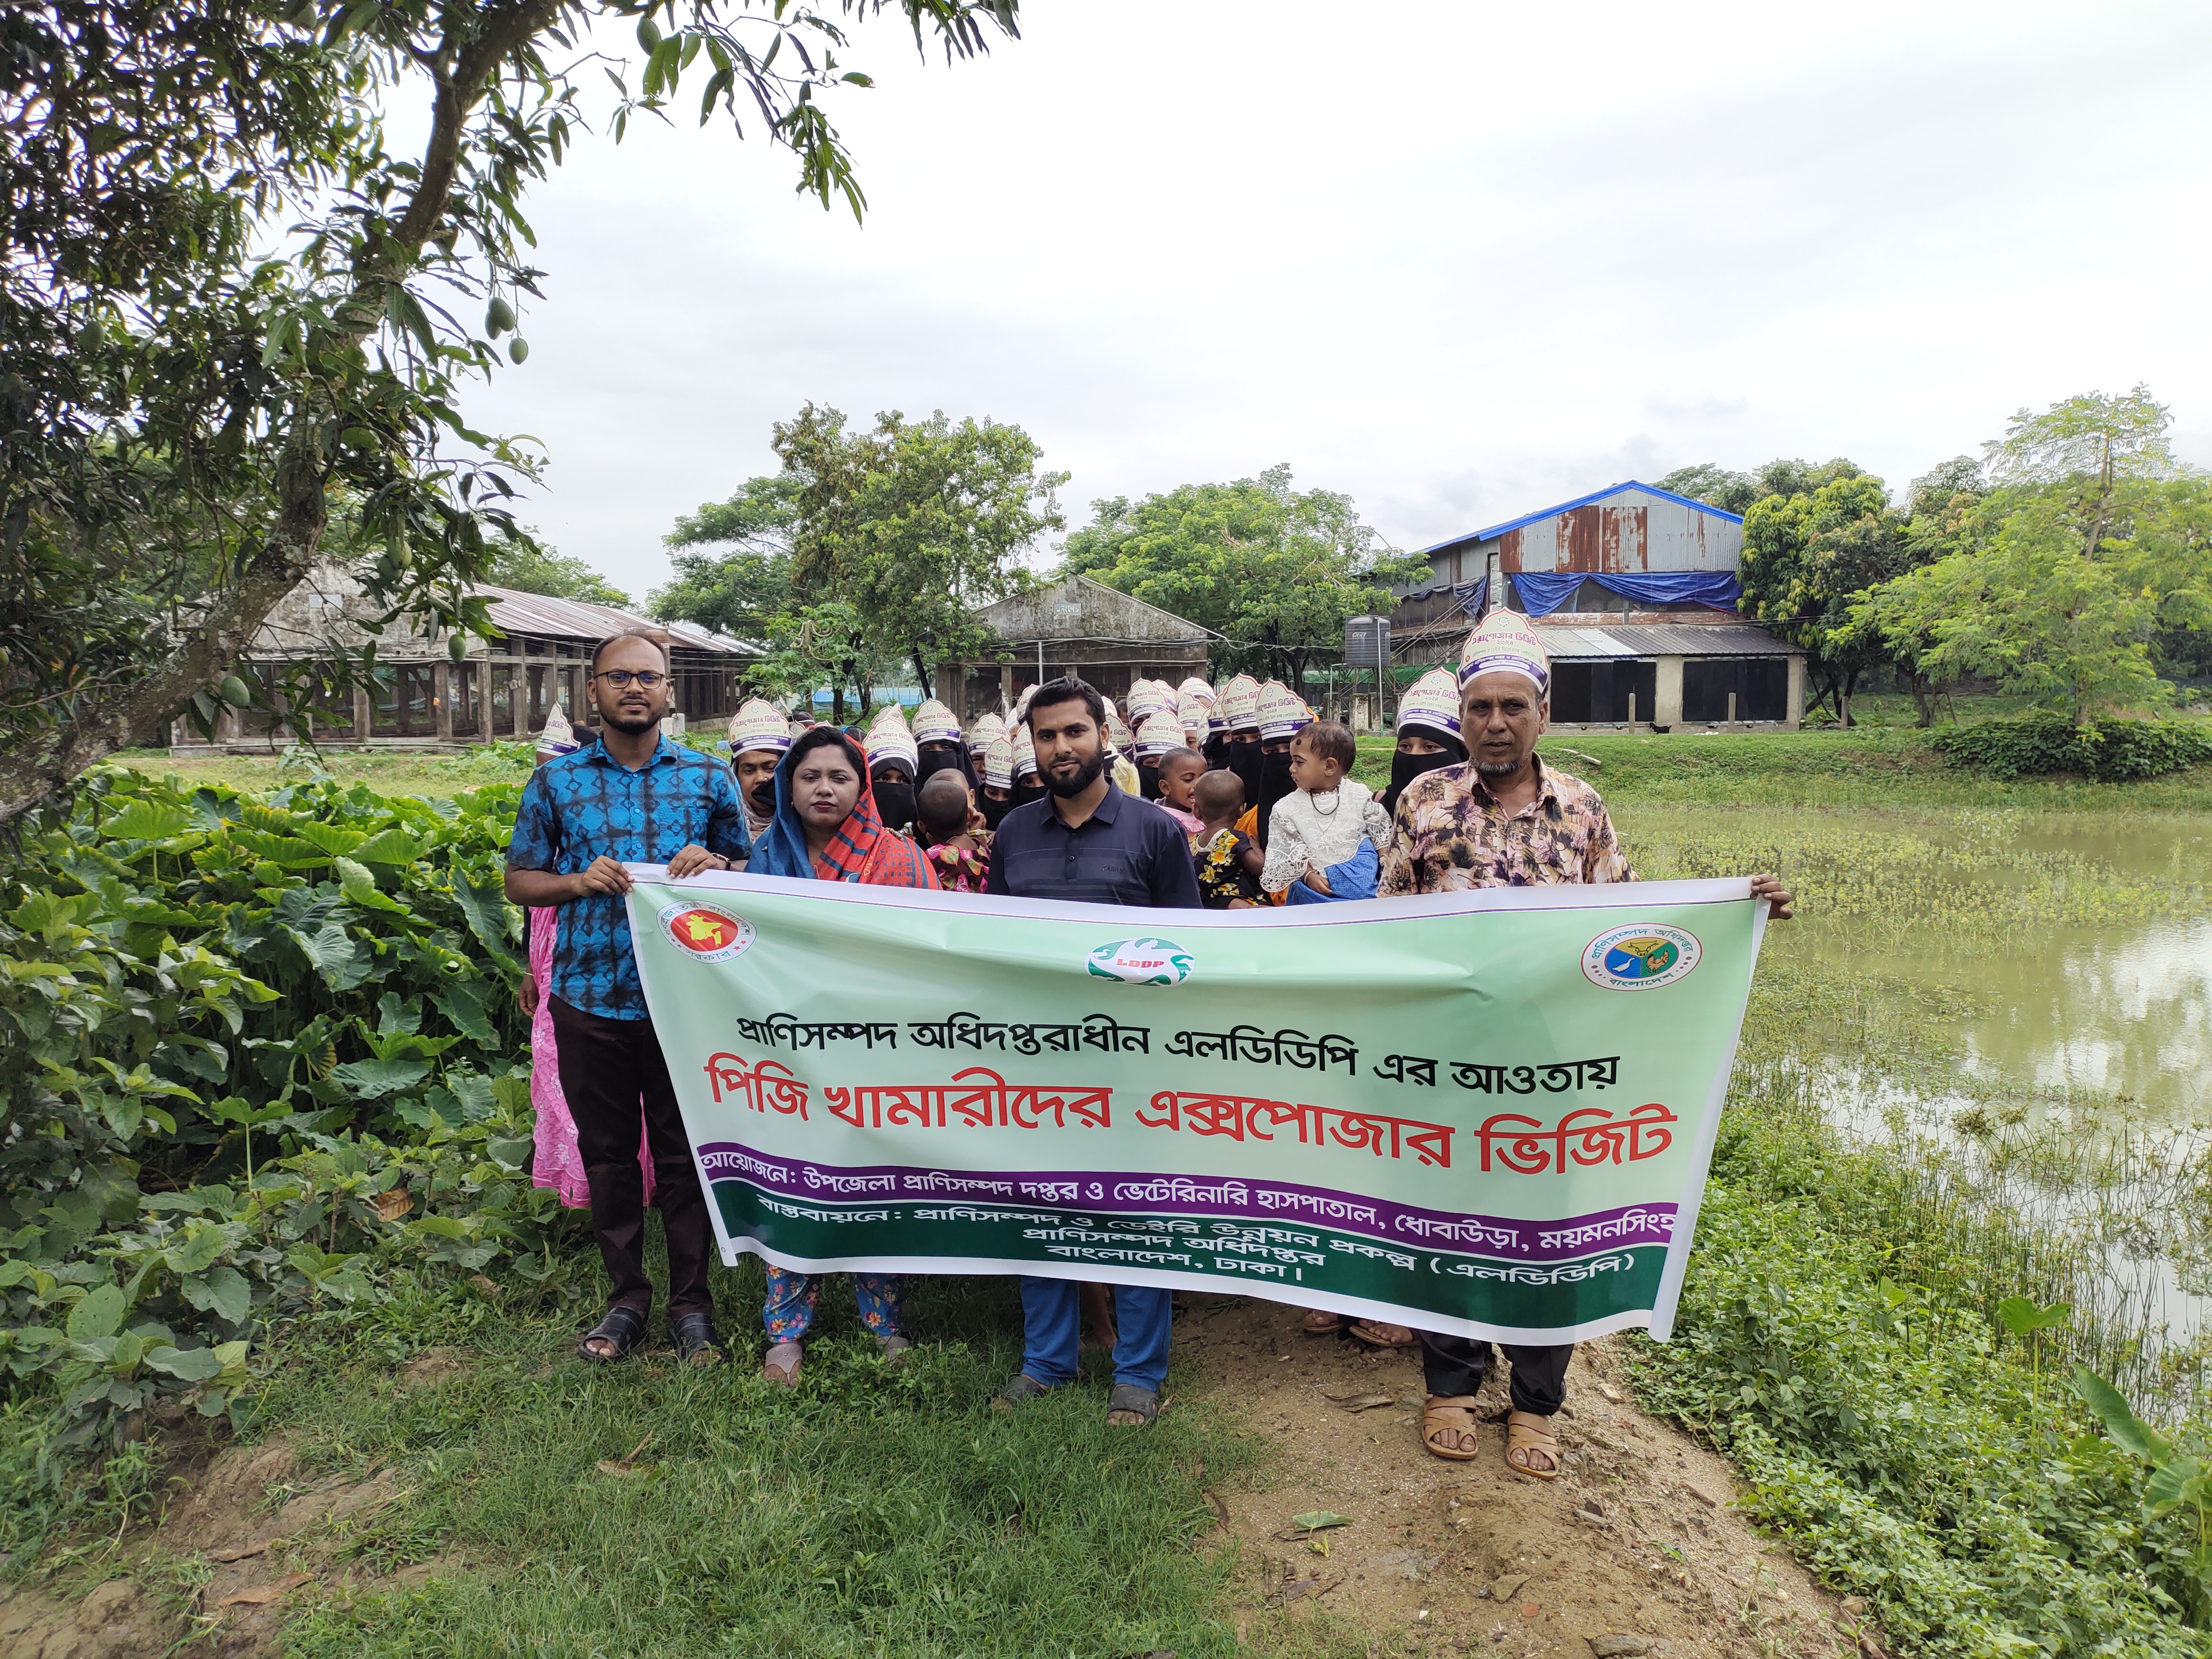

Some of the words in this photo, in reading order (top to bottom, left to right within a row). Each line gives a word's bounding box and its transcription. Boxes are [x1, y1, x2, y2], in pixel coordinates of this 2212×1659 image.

[1515, 632, 1537, 646] ভিজিট
[707, 904, 751, 936] বাংলাদেশ
[685, 949, 732, 961] সরকার
[1591, 928, 1650, 960] প্রাণিসম্পদ
[1654, 928, 1694, 952] অধিদপ্তর
[1116, 958, 1165, 969] LDDP
[1609, 973, 1675, 987] বাংলাদেশ
[736, 1012, 898, 1051] প্রাণিসম্পদ
[907, 1011, 1151, 1056] অধিদপ্তরাধীন
[1164, 1025, 1359, 1076] এলডিডিপি
[1373, 1054, 1439, 1087] এর
[1449, 1056, 1621, 1094] আওতায়
[704, 1051, 809, 1122] পিজি
[824, 1067, 1113, 1129] খামারীদের
[1135, 1091, 1455, 1169] এক্সপোজার
[1474, 1103, 1678, 1175] ভিজিট
[802, 1166, 896, 1193] উপজেলা
[903, 1172, 1013, 1197] প্রাণিসম্পদ
[1019, 1182, 1079, 1202] দপ্তর
[1085, 1182, 1104, 1201] ও
[1113, 1178, 1249, 1206] ভেটেরিনারি
[1255, 1190, 1386, 1230] হাসপাতাল,
[1395, 1214, 1529, 1252] ধোবাউড়া,
[1538, 1208, 1677, 1249] ময়মনসিংহ
[913, 1206, 1062, 1226] প্রাণিসম্পদ
[1070, 1217, 1094, 1227] ও
[1107, 1220, 1201, 1234] ডেইরি
[1209, 1223, 1320, 1247] উন্নয়ন
[1329, 1239, 1418, 1271] প্রকল্প
[1430, 1253, 1635, 1286] (এলডিডিপি)
[1022, 1227, 1175, 1248] প্রাণিসম্পদ
[1182, 1236, 1326, 1266] অধিদপ্তর
[1045, 1246, 1203, 1269] বাংলাদেশ,
